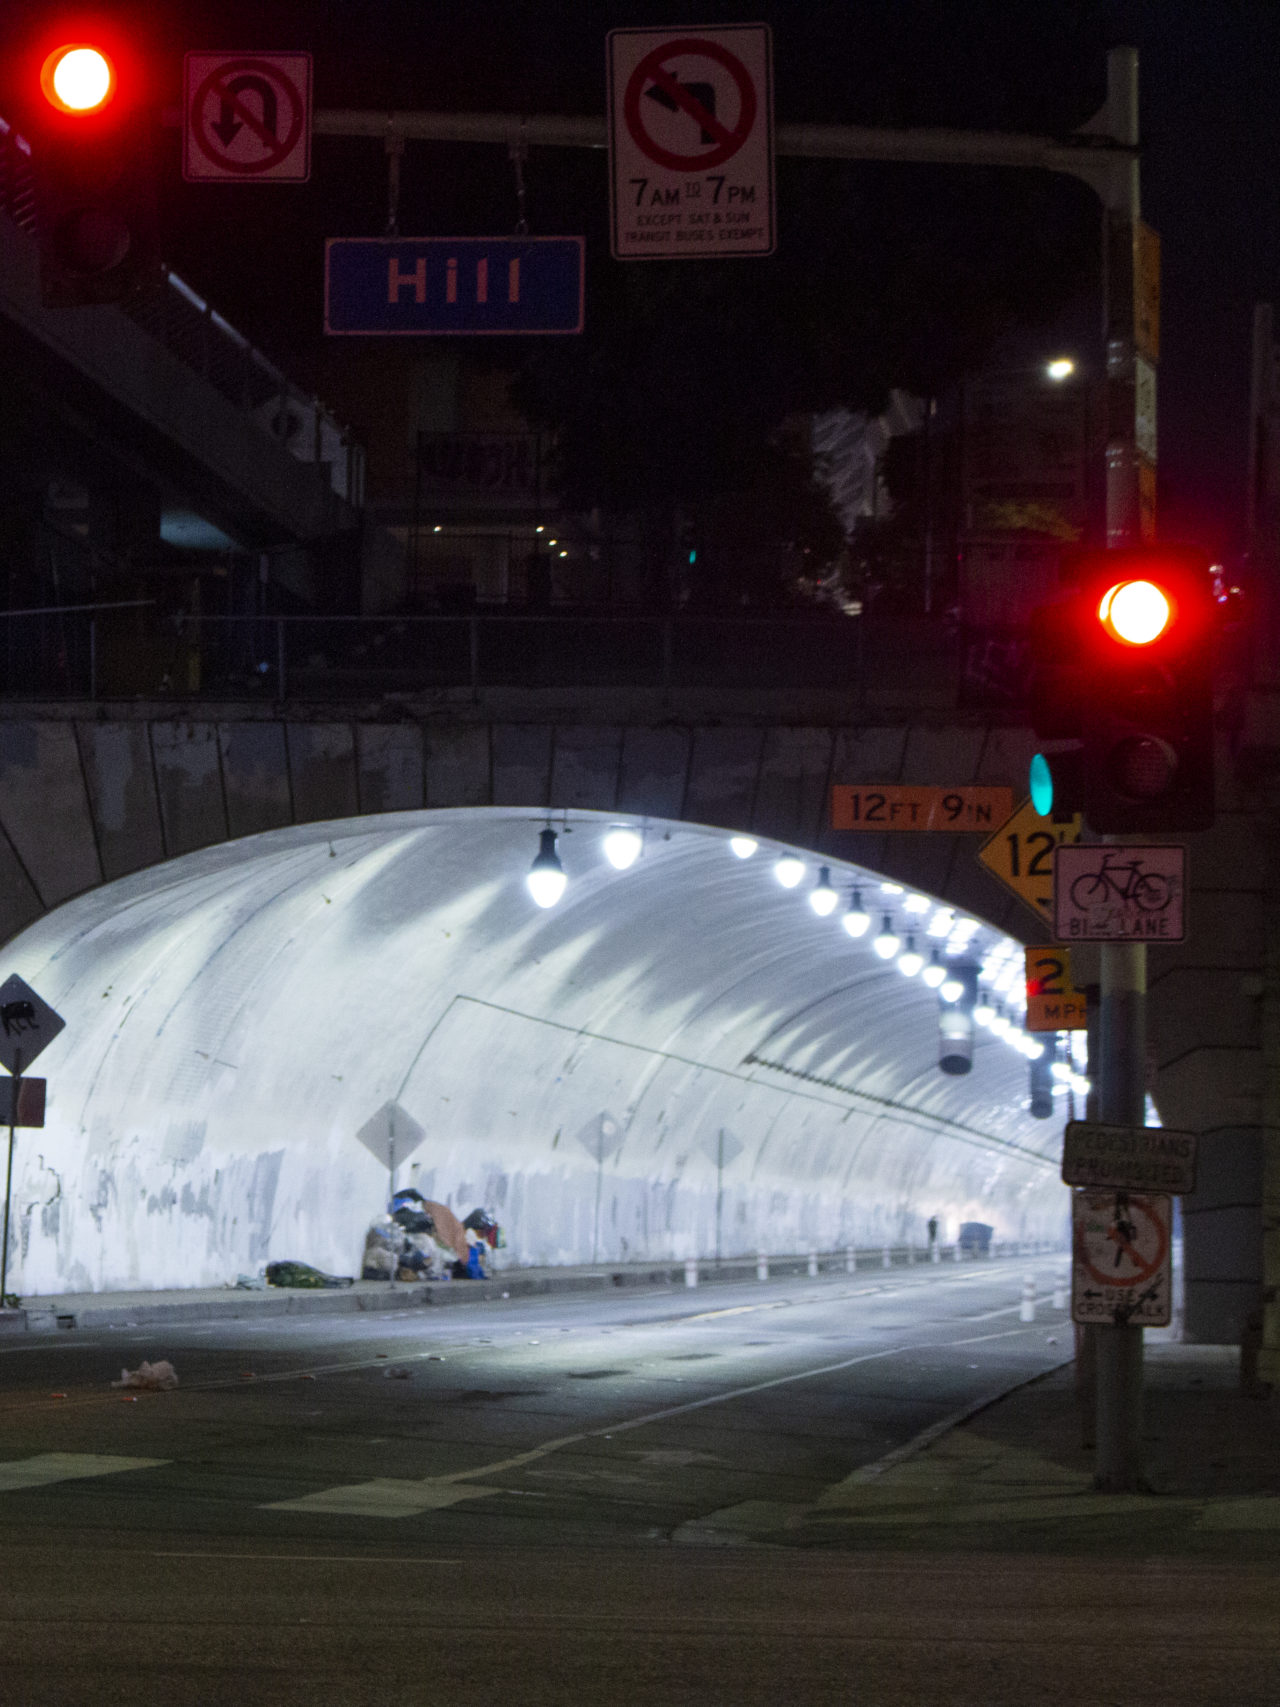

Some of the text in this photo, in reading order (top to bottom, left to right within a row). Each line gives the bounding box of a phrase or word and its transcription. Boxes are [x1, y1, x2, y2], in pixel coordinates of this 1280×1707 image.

[637, 213, 682, 226] EXCEPT
[725, 211, 750, 224] SUN
[625, 227, 764, 243] TRANSIT BUSES EXEMPT
[388, 257, 520, 304] Hill
[1070, 917, 1169, 936] BI LANE
[1105, 1288, 1135, 1302] USE
